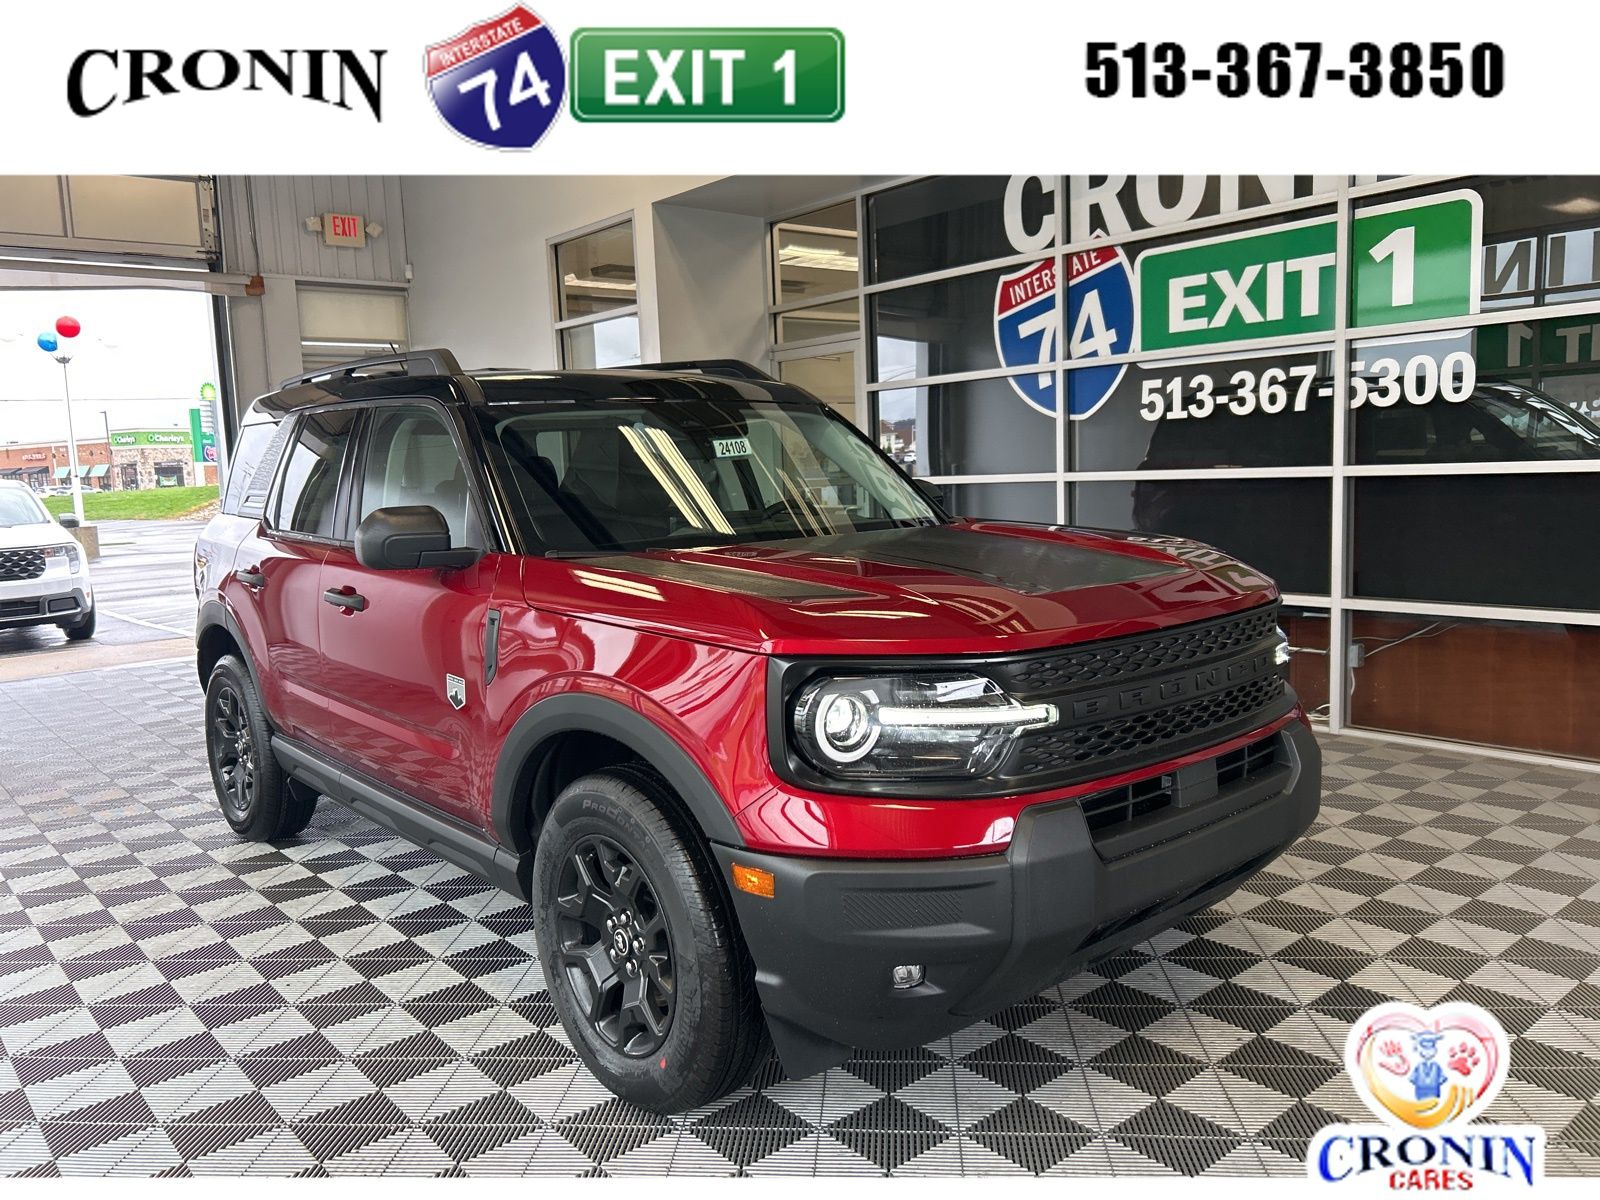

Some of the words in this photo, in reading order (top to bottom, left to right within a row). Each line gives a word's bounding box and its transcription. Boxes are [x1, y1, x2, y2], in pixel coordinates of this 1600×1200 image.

[332, 215, 359, 238] EXIT
[1168, 252, 1337, 334] EXIT
[1369, 226, 1415, 307] 1
[1017, 289, 1118, 390] 74
[1139, 351, 1477, 422] 513-367-5300
[719, 440, 747, 456] 24108
